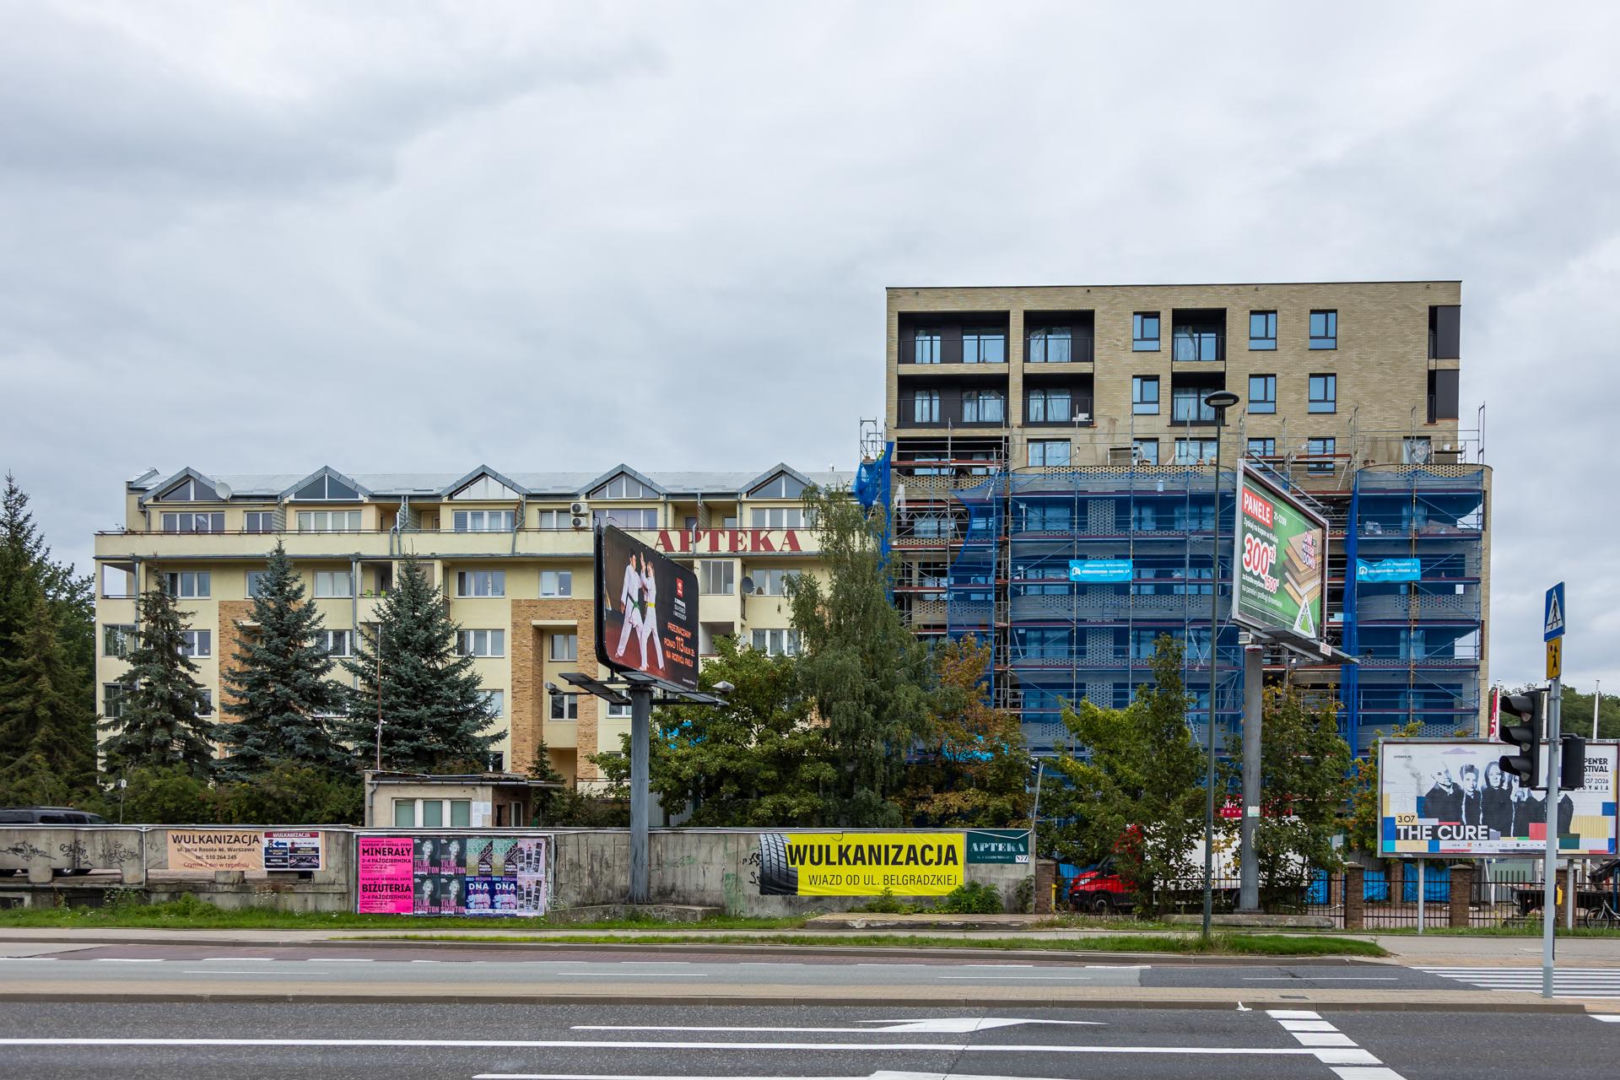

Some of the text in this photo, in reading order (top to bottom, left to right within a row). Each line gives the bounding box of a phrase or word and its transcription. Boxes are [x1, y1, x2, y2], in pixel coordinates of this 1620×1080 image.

[1244, 492, 1271, 524] PANELE
[654, 529, 802, 553] APTEKA
[1243, 533, 1269, 577] 300
[1397, 825, 1489, 840] THE CURE
[171, 834, 260, 846] WULKANIZACJA
[362, 847, 412, 856] MINERAŁY
[970, 842, 1025, 852] APTEKA
[787, 844, 959, 866] WULKANIZACJA
[362, 881, 412, 892] BIŻUTERIA
[808, 874, 957, 886] WJAZD OD UL. BELGRADZKIEJ
